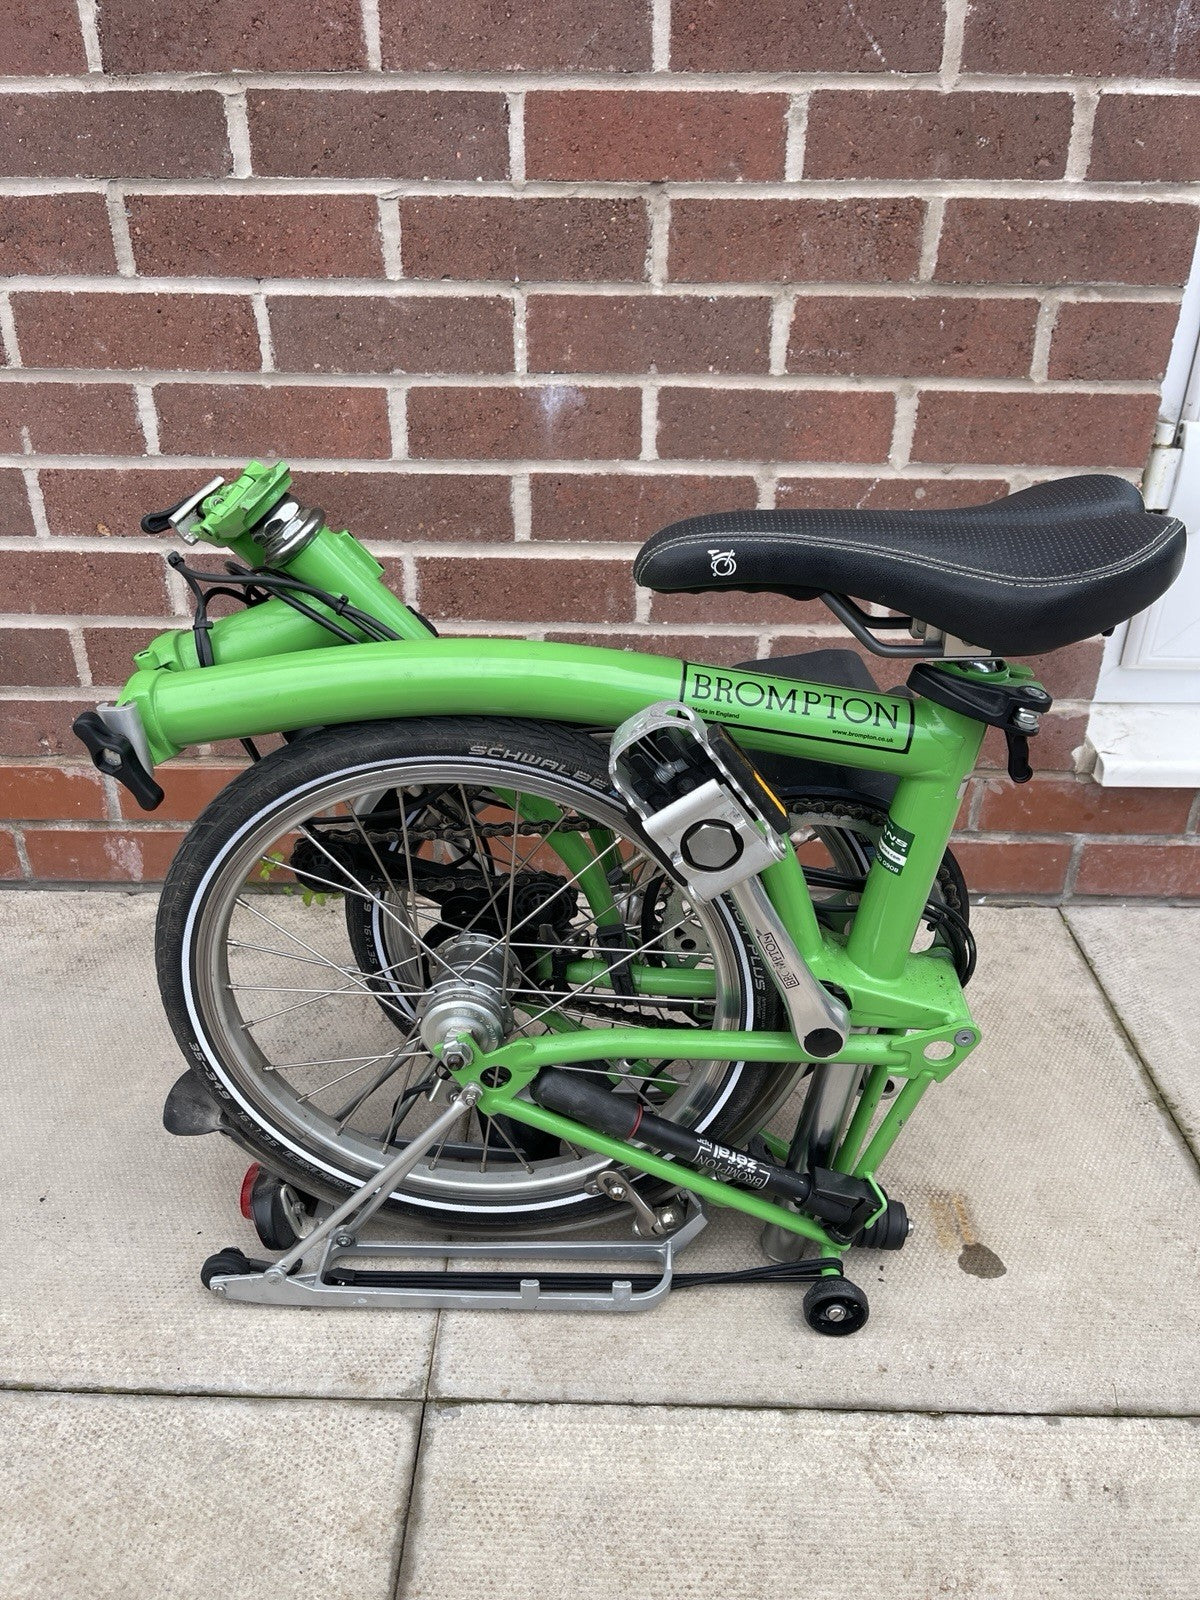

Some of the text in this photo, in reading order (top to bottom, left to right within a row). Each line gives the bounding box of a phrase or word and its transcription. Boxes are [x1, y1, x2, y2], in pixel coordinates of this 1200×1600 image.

[691, 706, 708, 715] Made
[716, 710, 740, 719] England
[692, 673, 901, 729] BROMPTON
[832, 729, 894, 743] www.brompton.co.uk
[469, 745, 609, 790] SCHWALBE
[747, 944, 766, 991] PLUS
[188, 1042, 233, 1100] 35-349
[699, 1154, 764, 1187] BROMPTON
